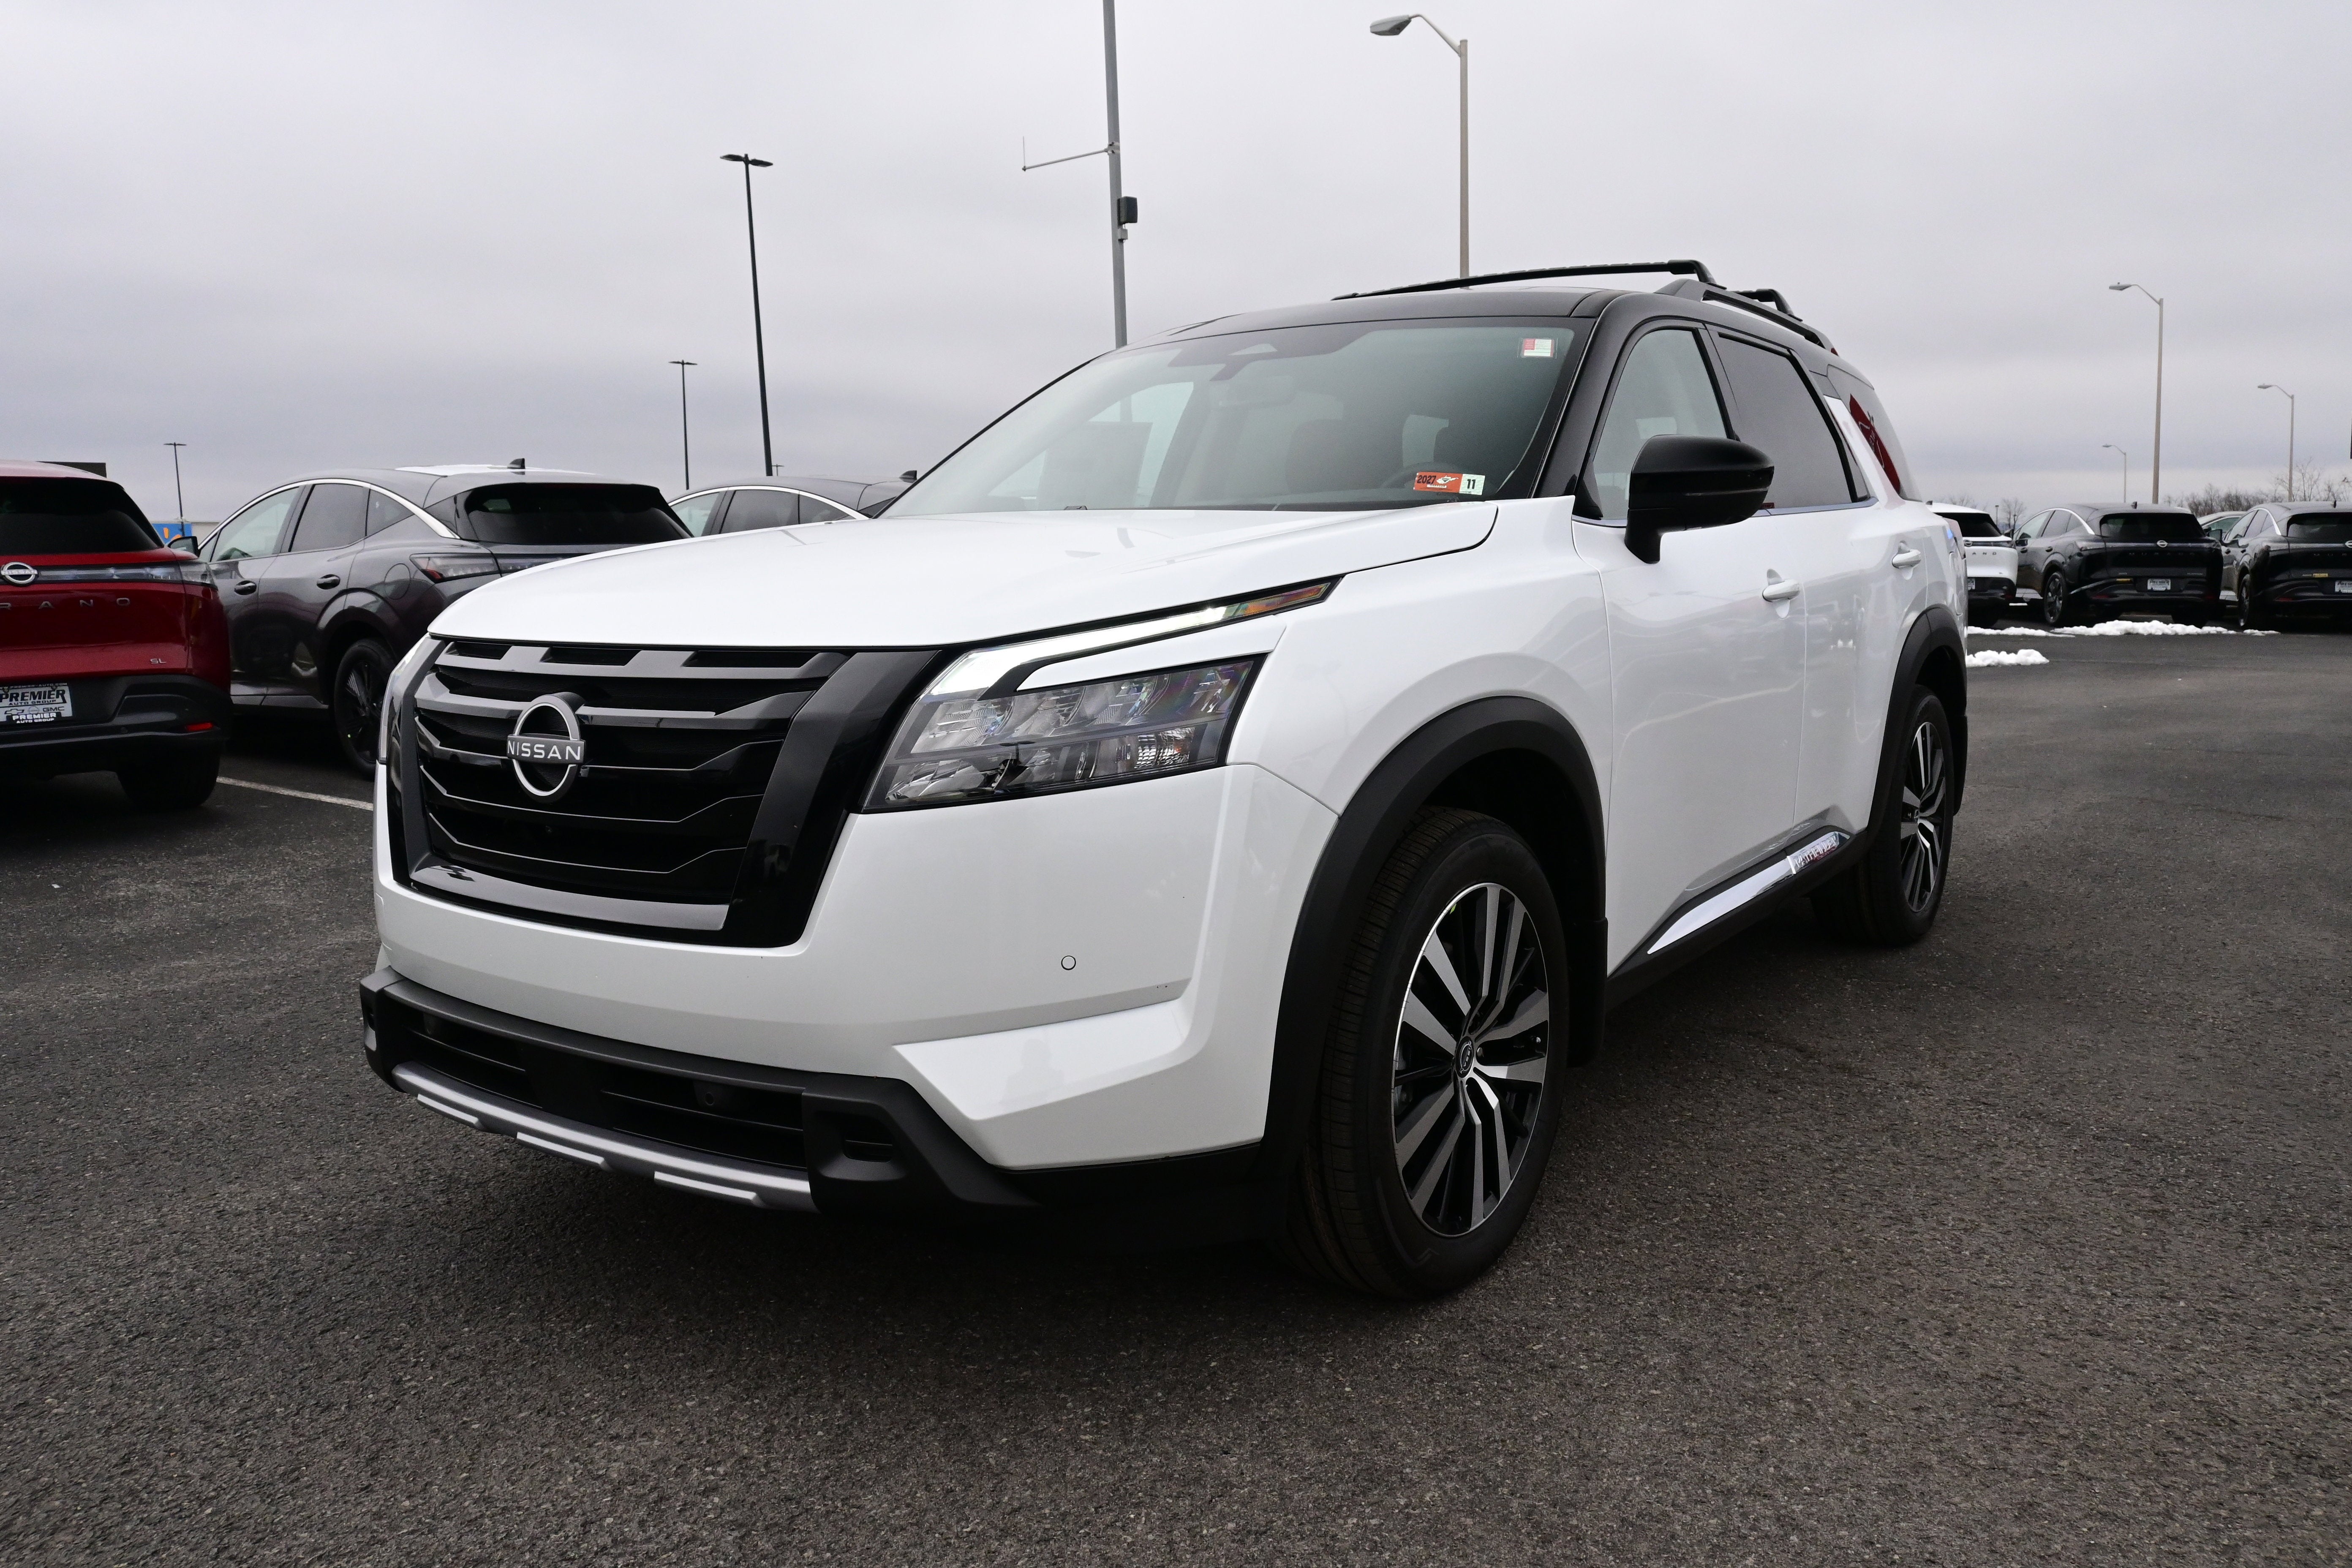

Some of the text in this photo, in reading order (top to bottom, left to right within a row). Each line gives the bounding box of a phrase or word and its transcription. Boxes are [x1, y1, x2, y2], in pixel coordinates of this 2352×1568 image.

[1416, 474, 1437, 485] 2027
[1466, 479, 1476, 490] 11
[0, 689, 67, 703] PREMIER
[12, 712, 57, 721] PREMIER
[507, 740, 581, 760] NISSAN
